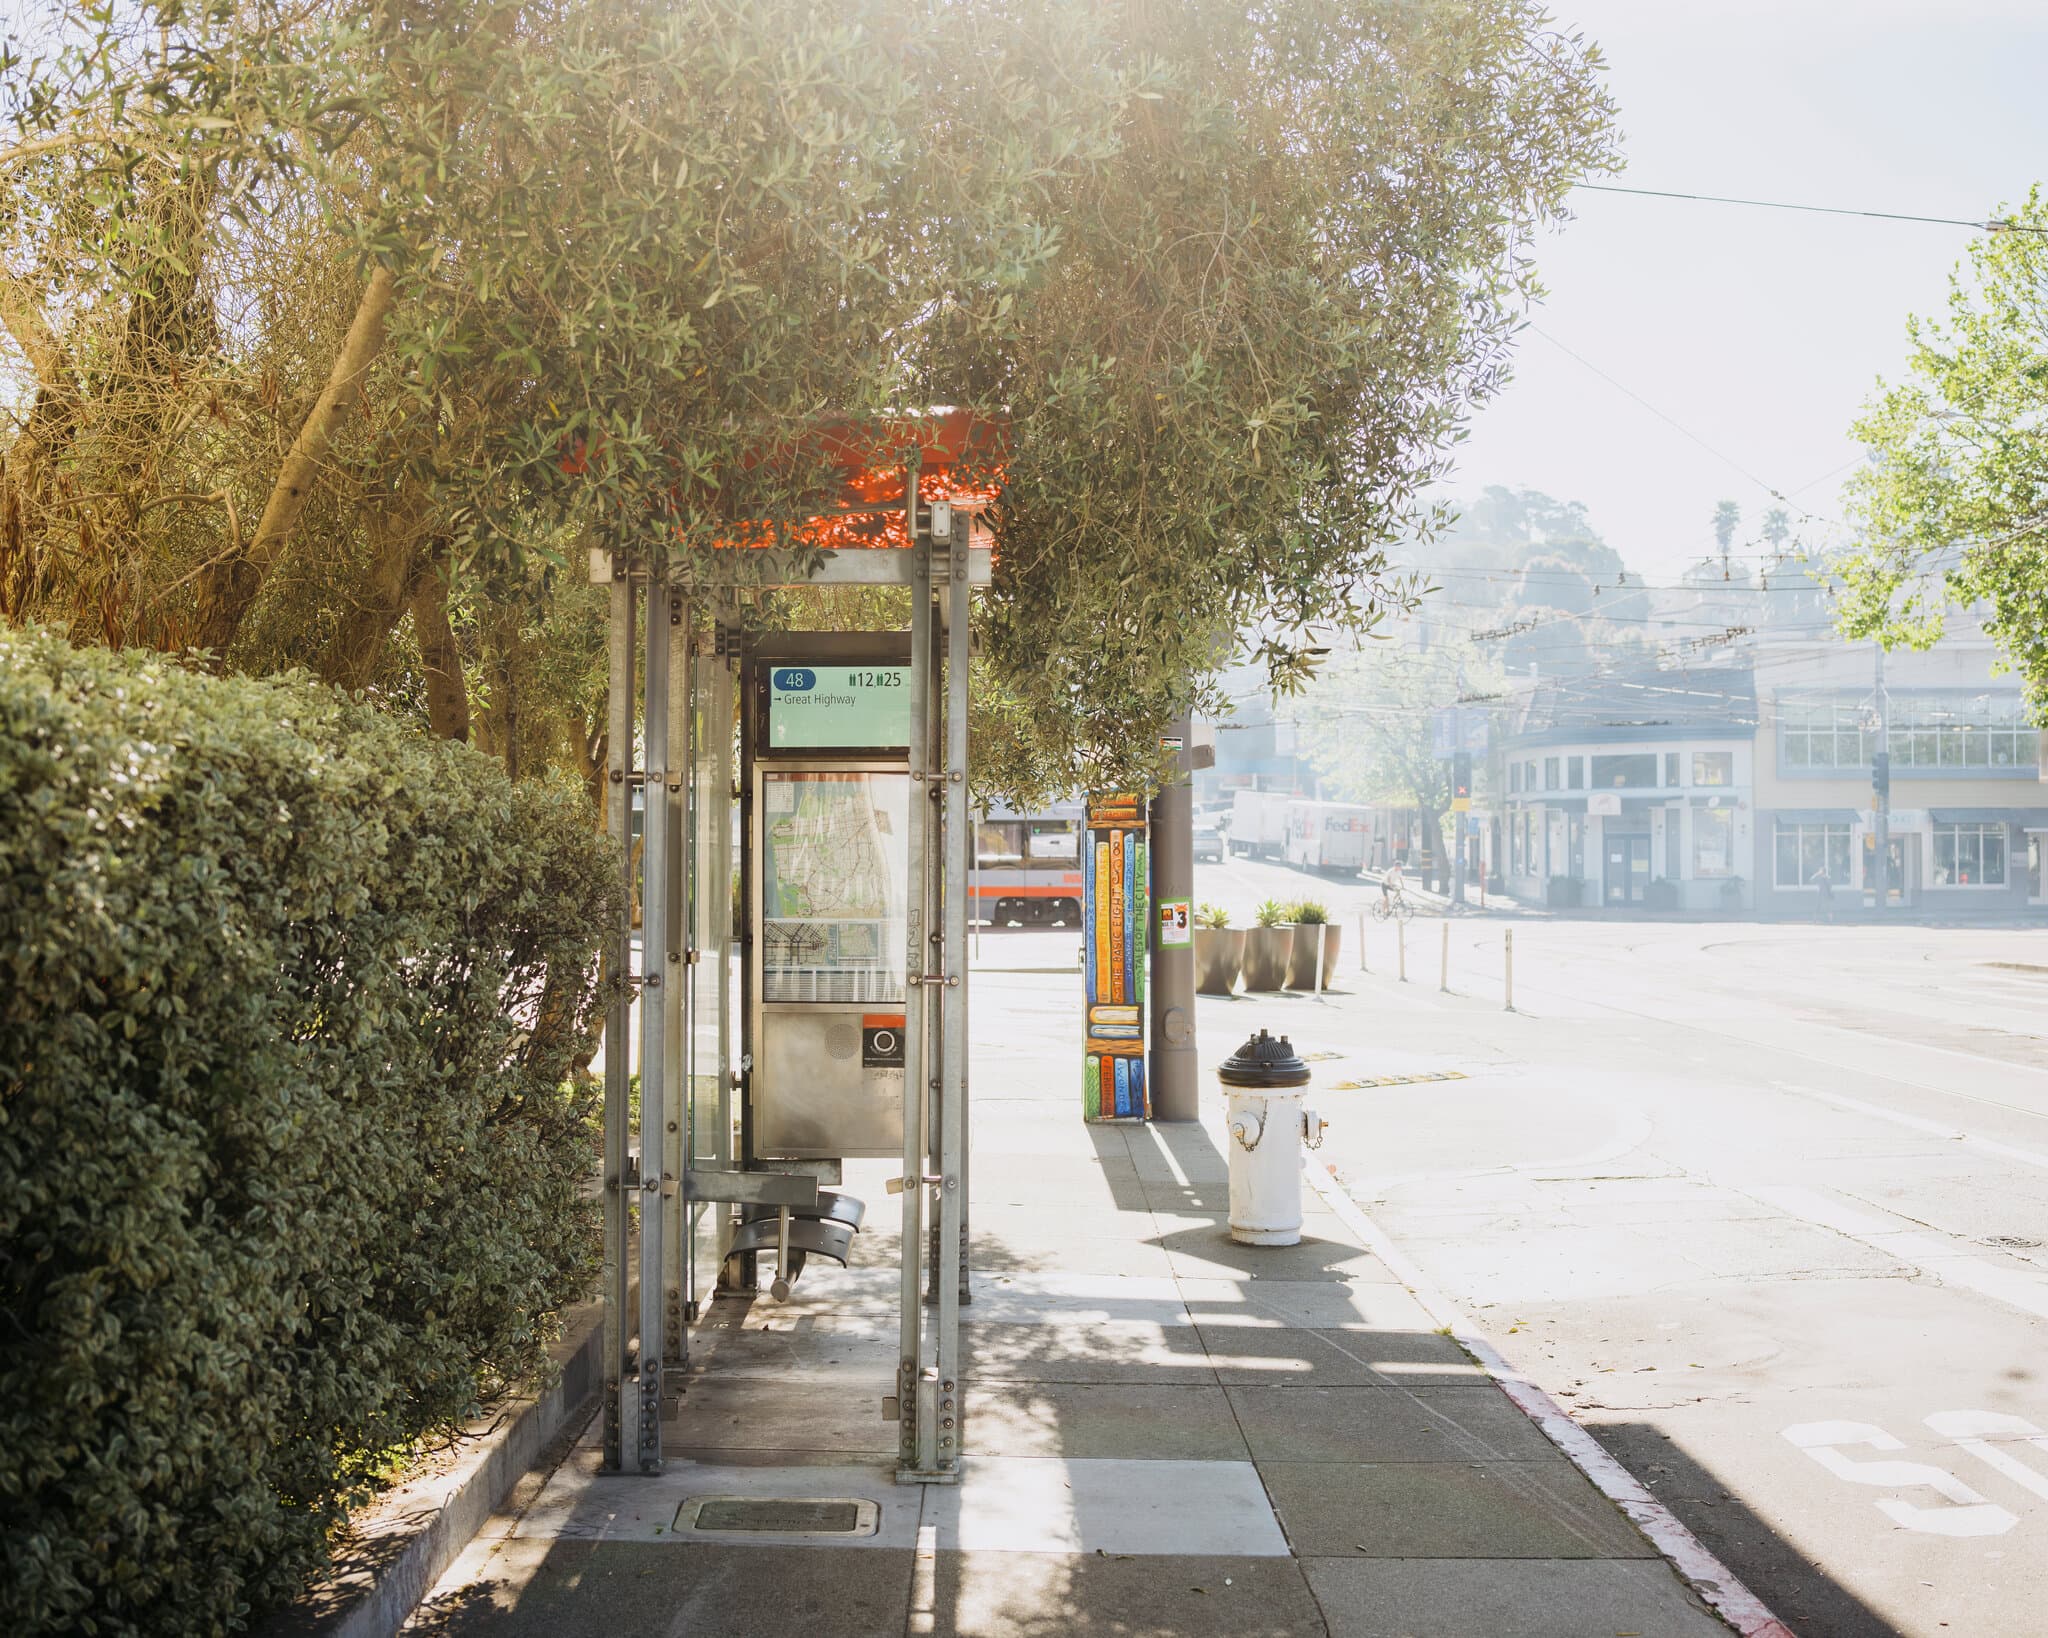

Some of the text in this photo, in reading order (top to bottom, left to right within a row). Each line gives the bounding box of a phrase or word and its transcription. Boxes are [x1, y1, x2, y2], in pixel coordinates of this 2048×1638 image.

[785, 673, 804, 687] 48
[884, 672, 901, 687] 25
[784, 693, 856, 707] Great Highway
[1325, 816, 1368, 832] FedEx
[1135, 872, 1145, 969] TALES OF THE CITY
[1176, 911, 1187, 929] 3
[1112, 887, 1122, 985] THE BASIC EIGHT
